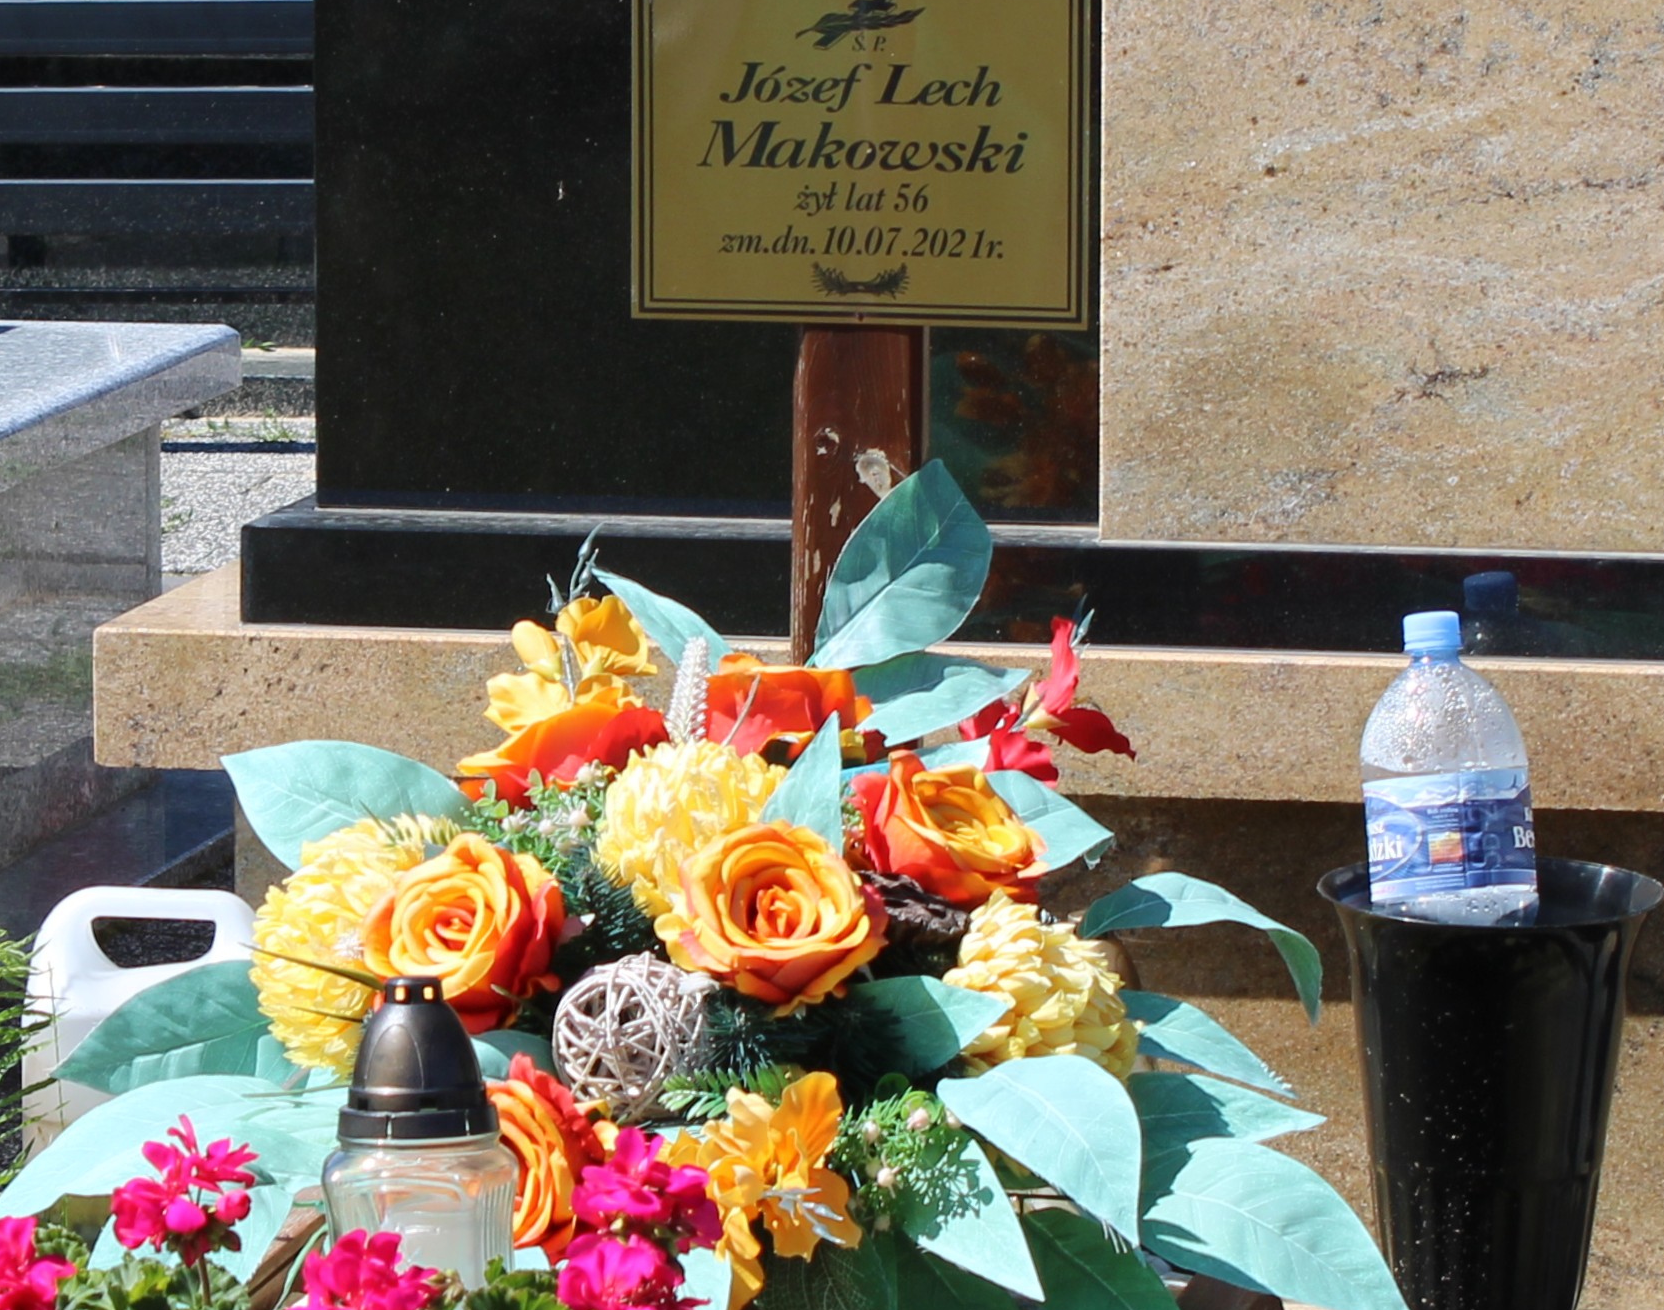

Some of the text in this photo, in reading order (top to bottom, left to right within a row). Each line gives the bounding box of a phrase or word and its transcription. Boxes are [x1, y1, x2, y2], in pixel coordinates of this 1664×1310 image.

[719, 61, 1002, 113] Józef Lech
[696, 119, 1029, 174] Makowski
[792, 180, 930, 217] żył lat 56
